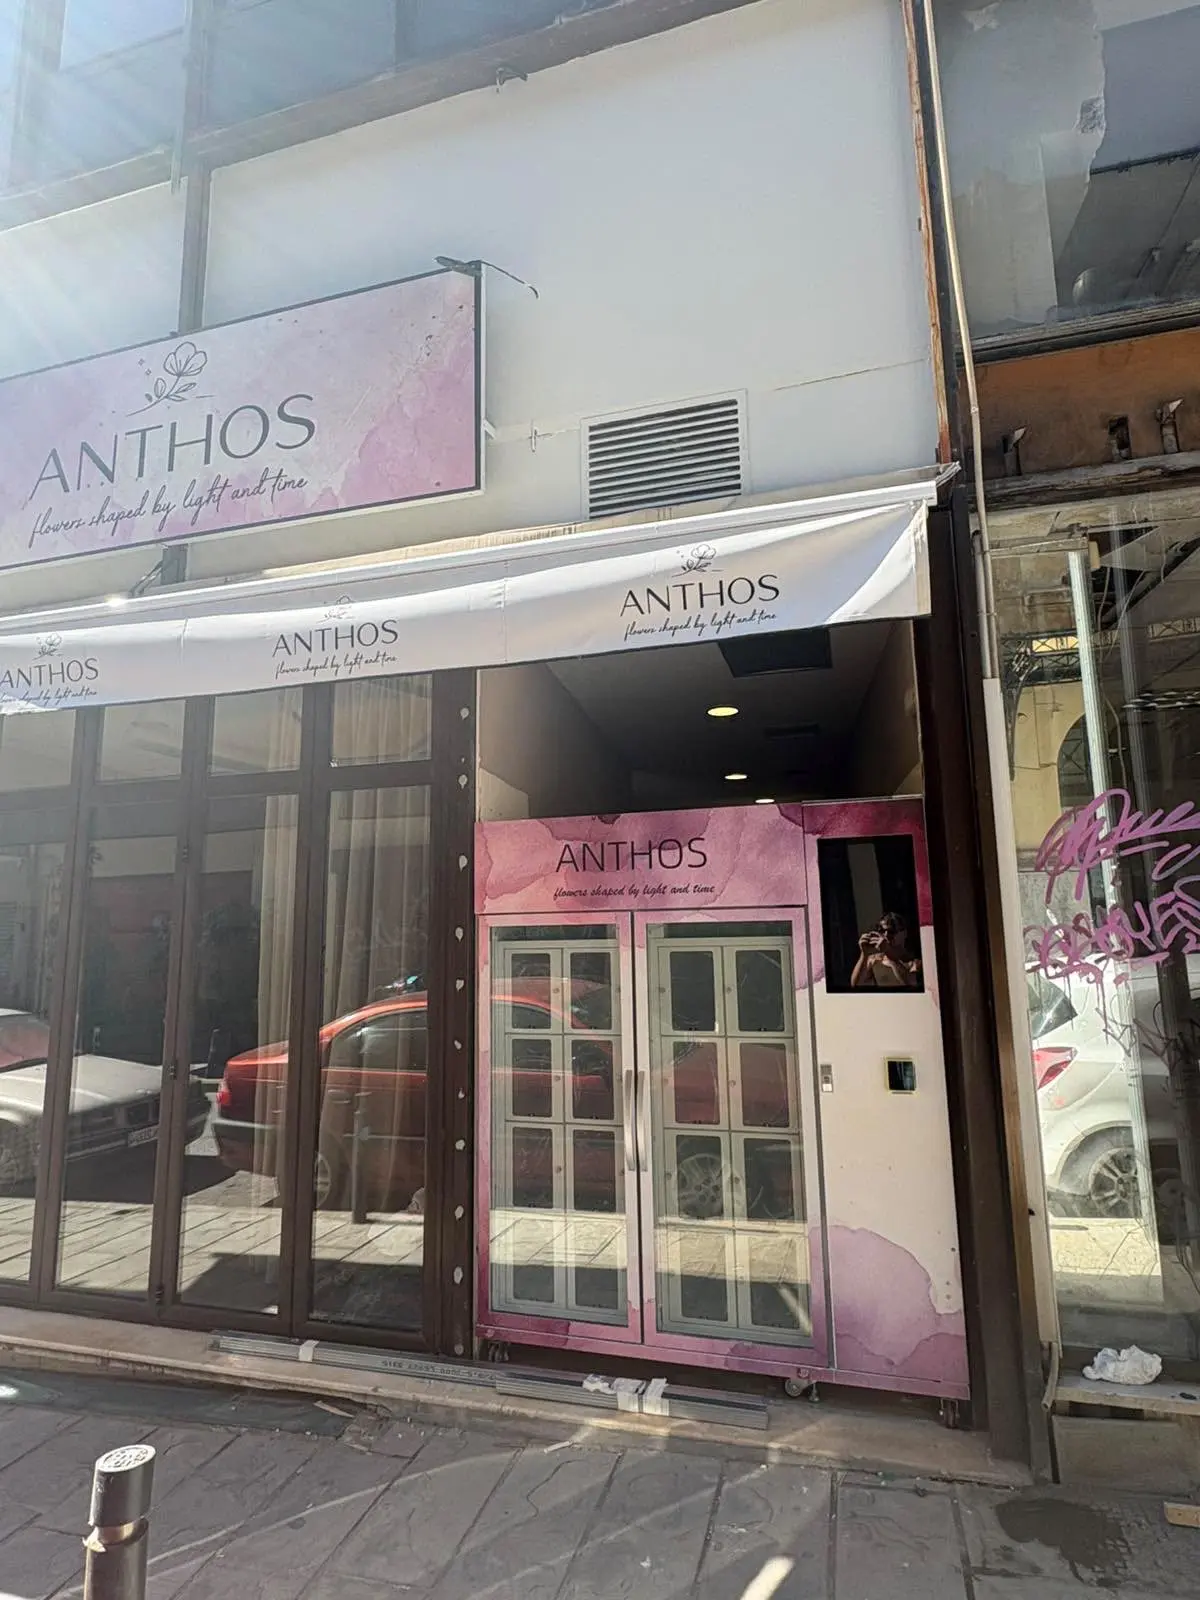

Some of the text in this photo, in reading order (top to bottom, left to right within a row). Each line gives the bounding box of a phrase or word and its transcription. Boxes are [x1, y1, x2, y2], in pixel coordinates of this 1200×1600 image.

[23, 393, 316, 510] ANTHOS
[28, 466, 308, 549] flowers shaped by light and time
[620, 574, 779, 617] ANTHOS
[272, 619, 398, 658] ANTHOS
[624, 609, 777, 641] flowers shaped by light and time
[0, 658, 99, 689] ANTHOS
[275, 660, 301, 680] flowers
[343, 651, 364, 675] light
[555, 837, 708, 873] ANTHOS
[553, 882, 715, 901] flowers shaped by light and time
